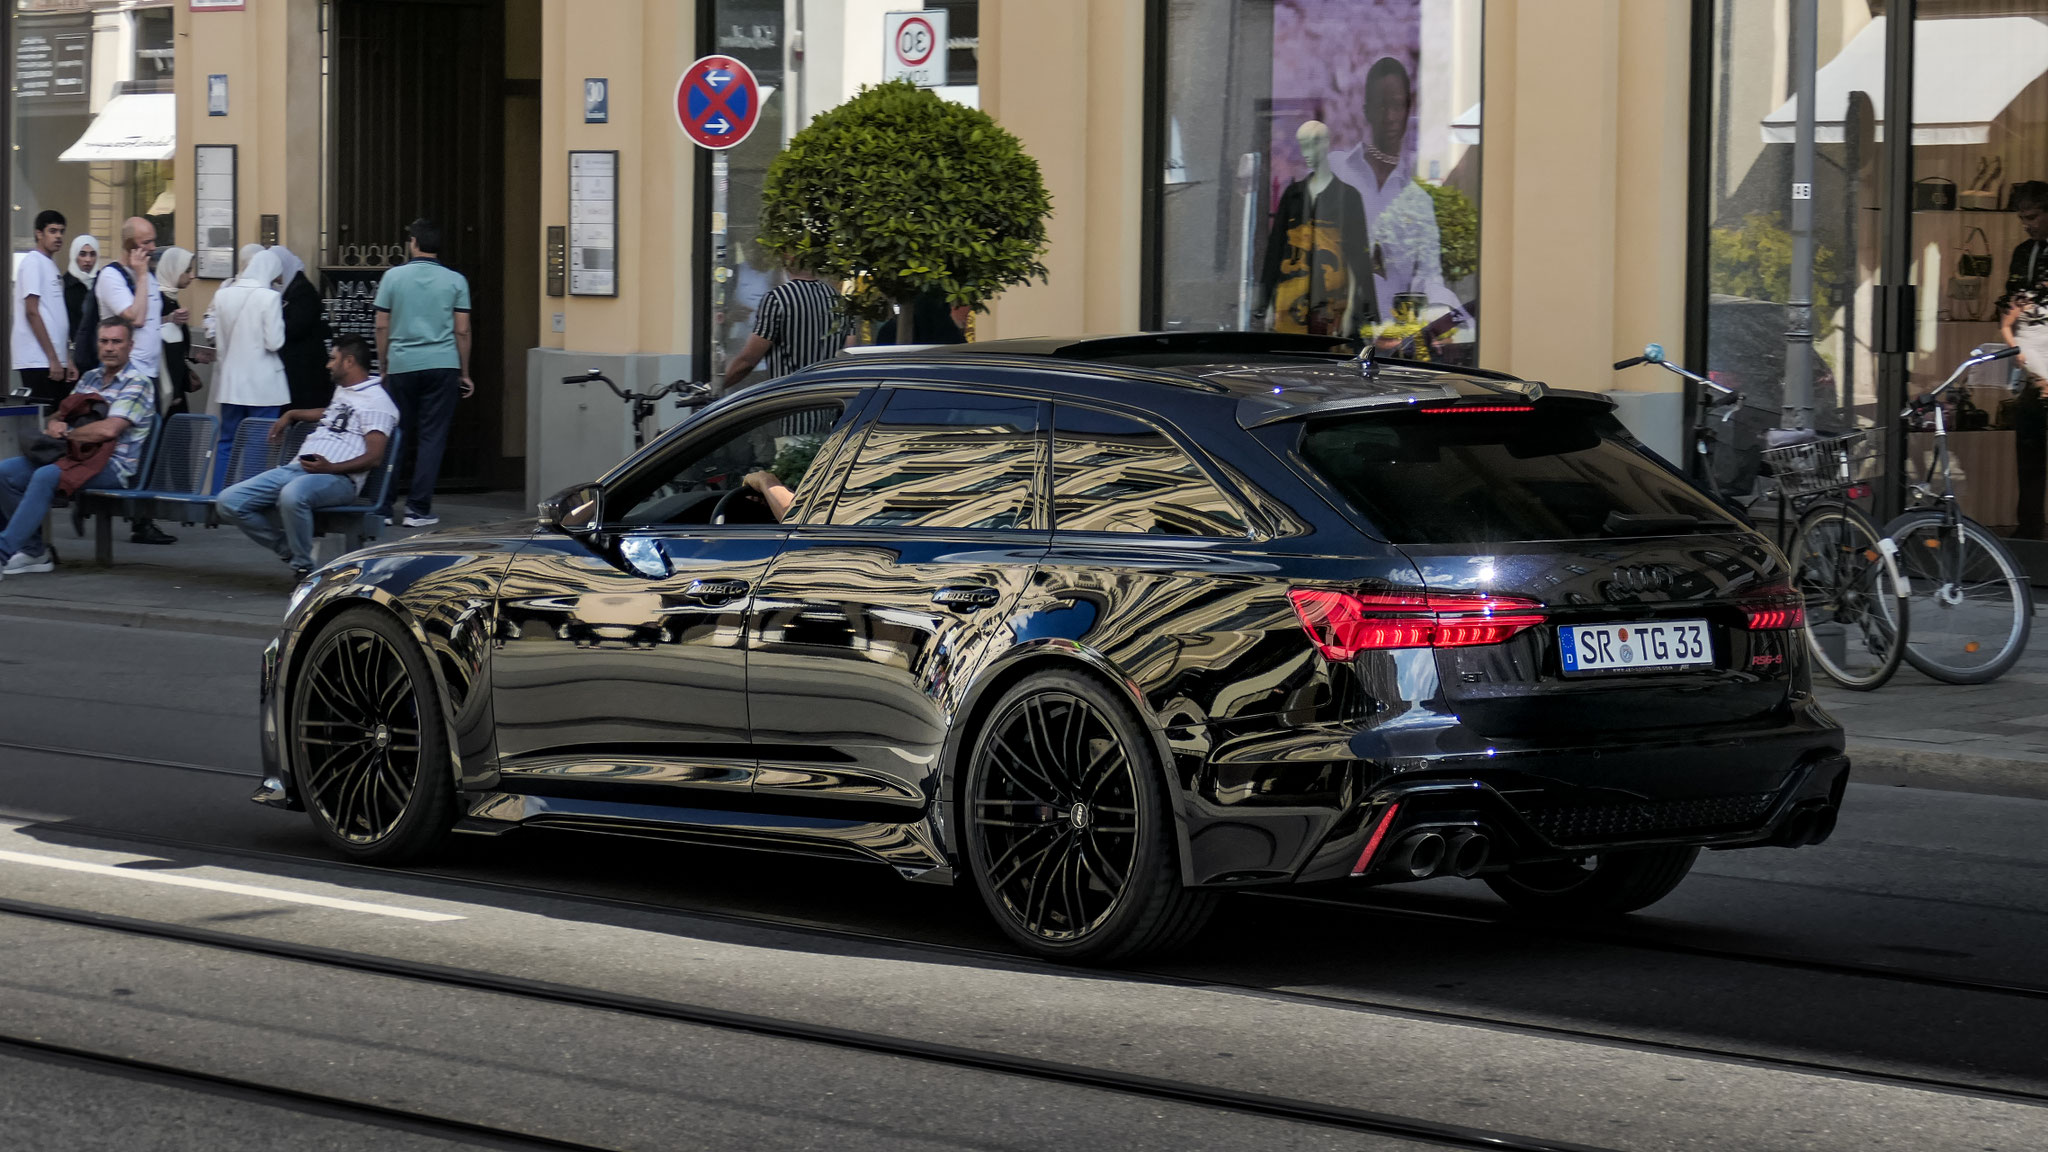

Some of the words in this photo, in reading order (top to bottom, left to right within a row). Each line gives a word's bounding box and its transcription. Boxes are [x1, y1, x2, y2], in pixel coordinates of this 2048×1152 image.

[1580, 630, 1615, 664] SR
[1634, 627, 1669, 661] TG
[1673, 625, 1704, 659] 33
[1566, 653, 1574, 664] D
